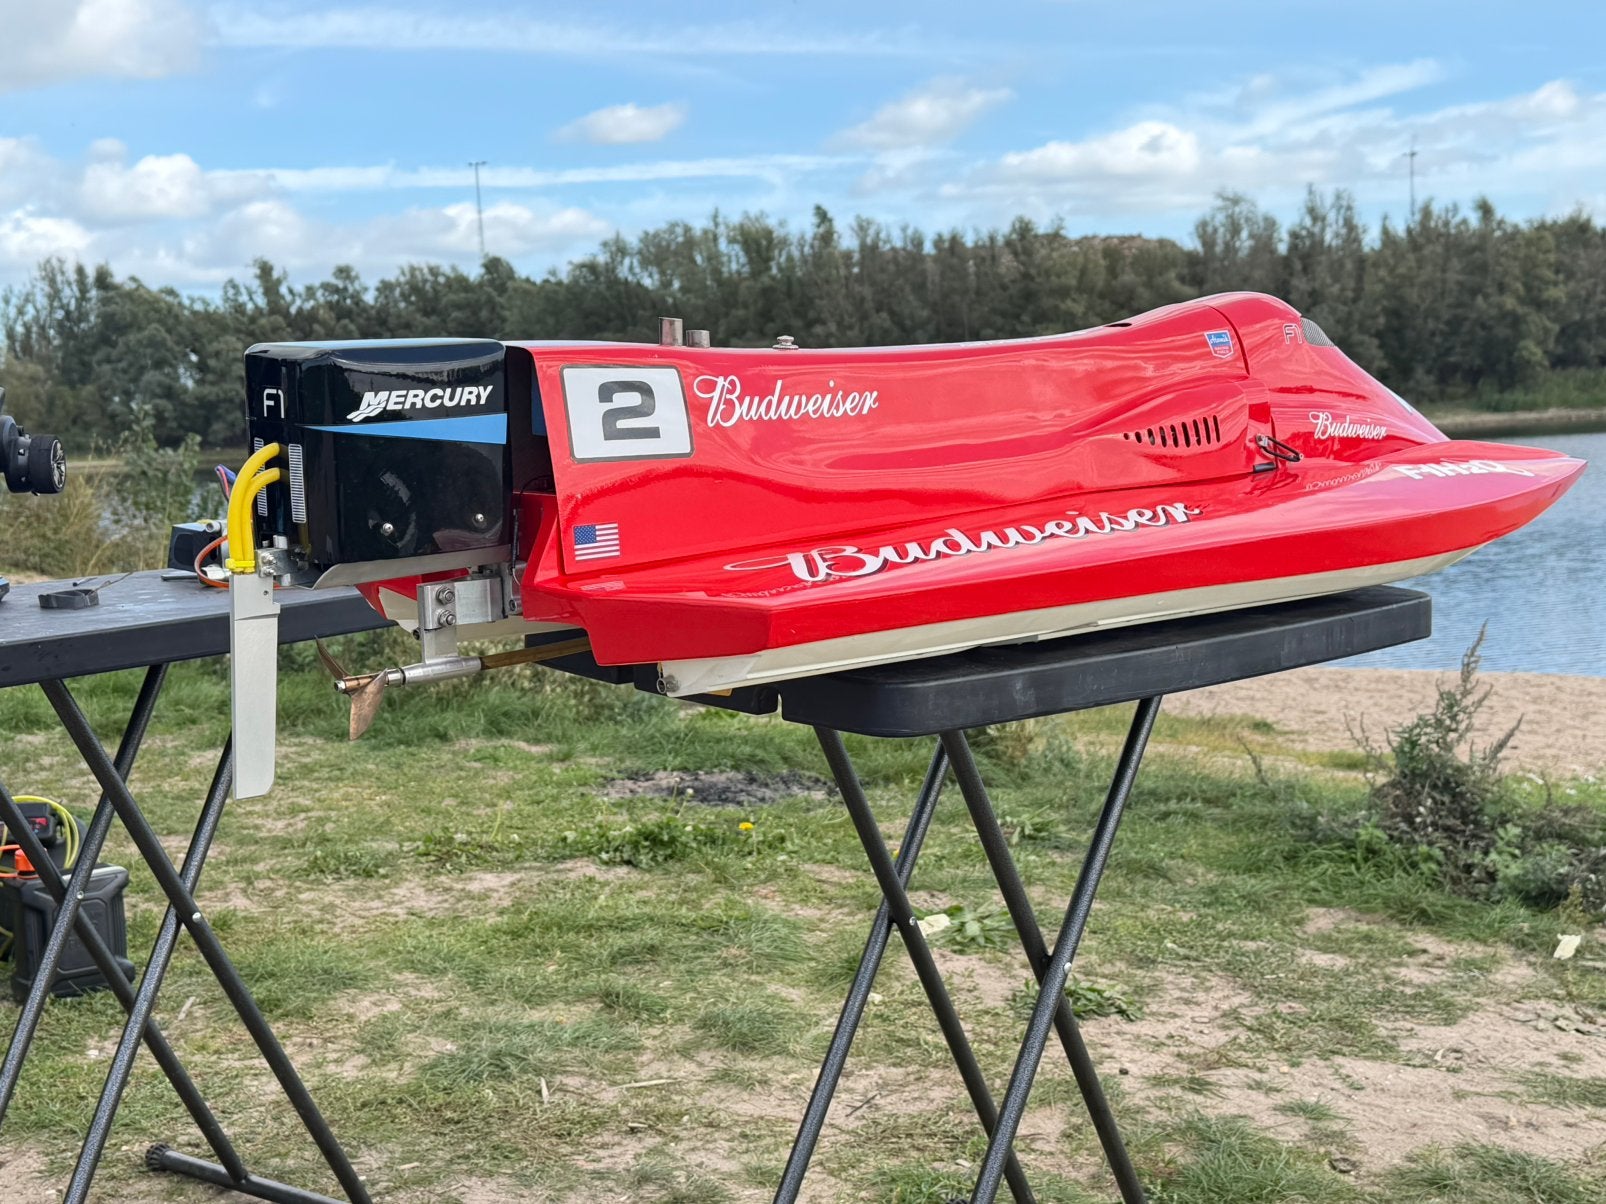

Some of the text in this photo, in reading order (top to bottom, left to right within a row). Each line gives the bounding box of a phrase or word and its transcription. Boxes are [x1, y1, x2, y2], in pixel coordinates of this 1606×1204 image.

[1283, 323, 1303, 345] F1
[264, 388, 285, 419] F1
[346, 385, 493, 423] MERCURY
[598, 381, 661, 441] 2
[694, 375, 879, 427] Budweiser
[1309, 411, 1387, 440] Budweiser
[724, 502, 1203, 583] Budweiser
